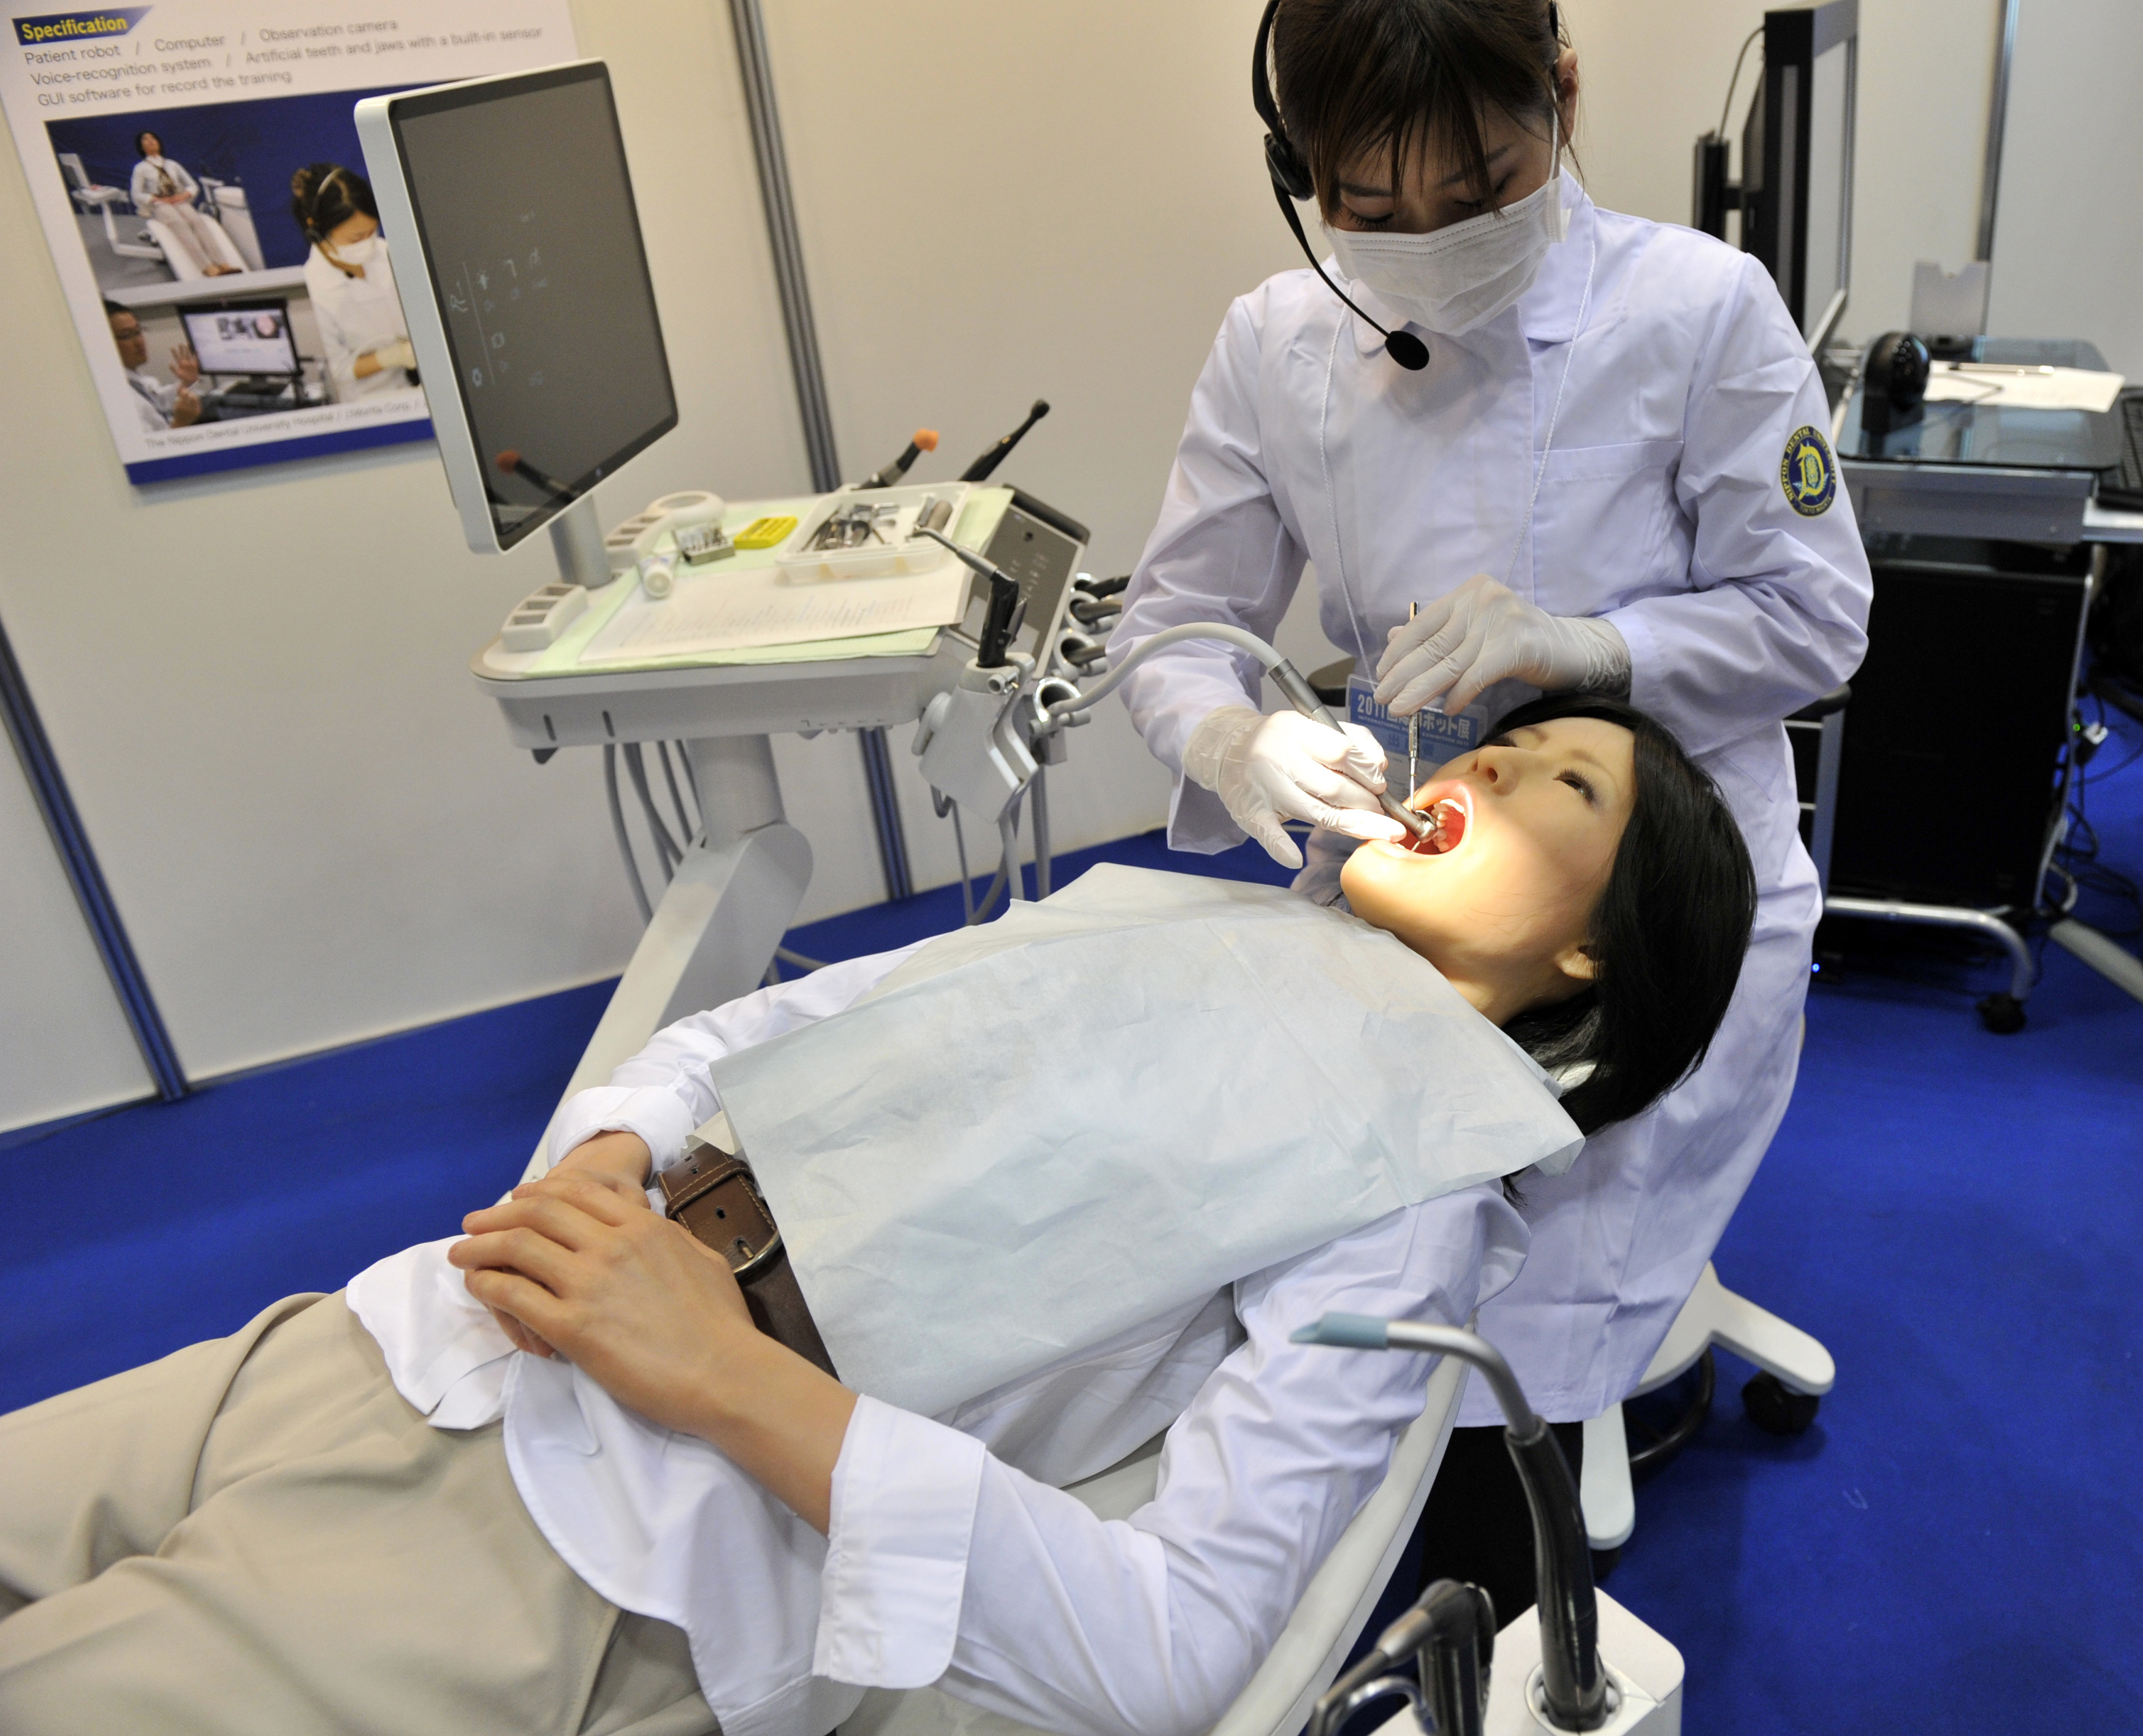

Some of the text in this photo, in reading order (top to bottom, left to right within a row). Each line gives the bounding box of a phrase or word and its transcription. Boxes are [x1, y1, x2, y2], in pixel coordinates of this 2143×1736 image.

[21, 16, 128, 42] Specification
[25, 48, 77, 64] Patient
[80, 45, 121, 59] robot
[154, 34, 225, 52] Computer
[259, 25, 344, 42] Observation
[346, 20, 398, 34] camera
[29, 62, 156, 85] Voice-recognition
[160, 58, 211, 74] system
[246, 48, 302, 63] Artificial
[305, 45, 343, 59] teeth
[345, 42, 370, 55] and
[375, 39, 404, 55] jaws
[407, 36, 436, 49] with
[440, 36, 447, 47] a
[451, 31, 497, 45] built-in
[499, 27, 542, 41] sensor
[37, 70, 293, 106] GUI software for record the training
[145, 438, 166, 448] The
[166, 433, 204, 447] Nippon
[205, 428, 240, 440] Dental
[241, 420, 291, 435] University
[291, 413, 334, 426] Hospital
[1785, 427, 1810, 454] DENTAL
[1781, 458, 1794, 501] NIPPON
